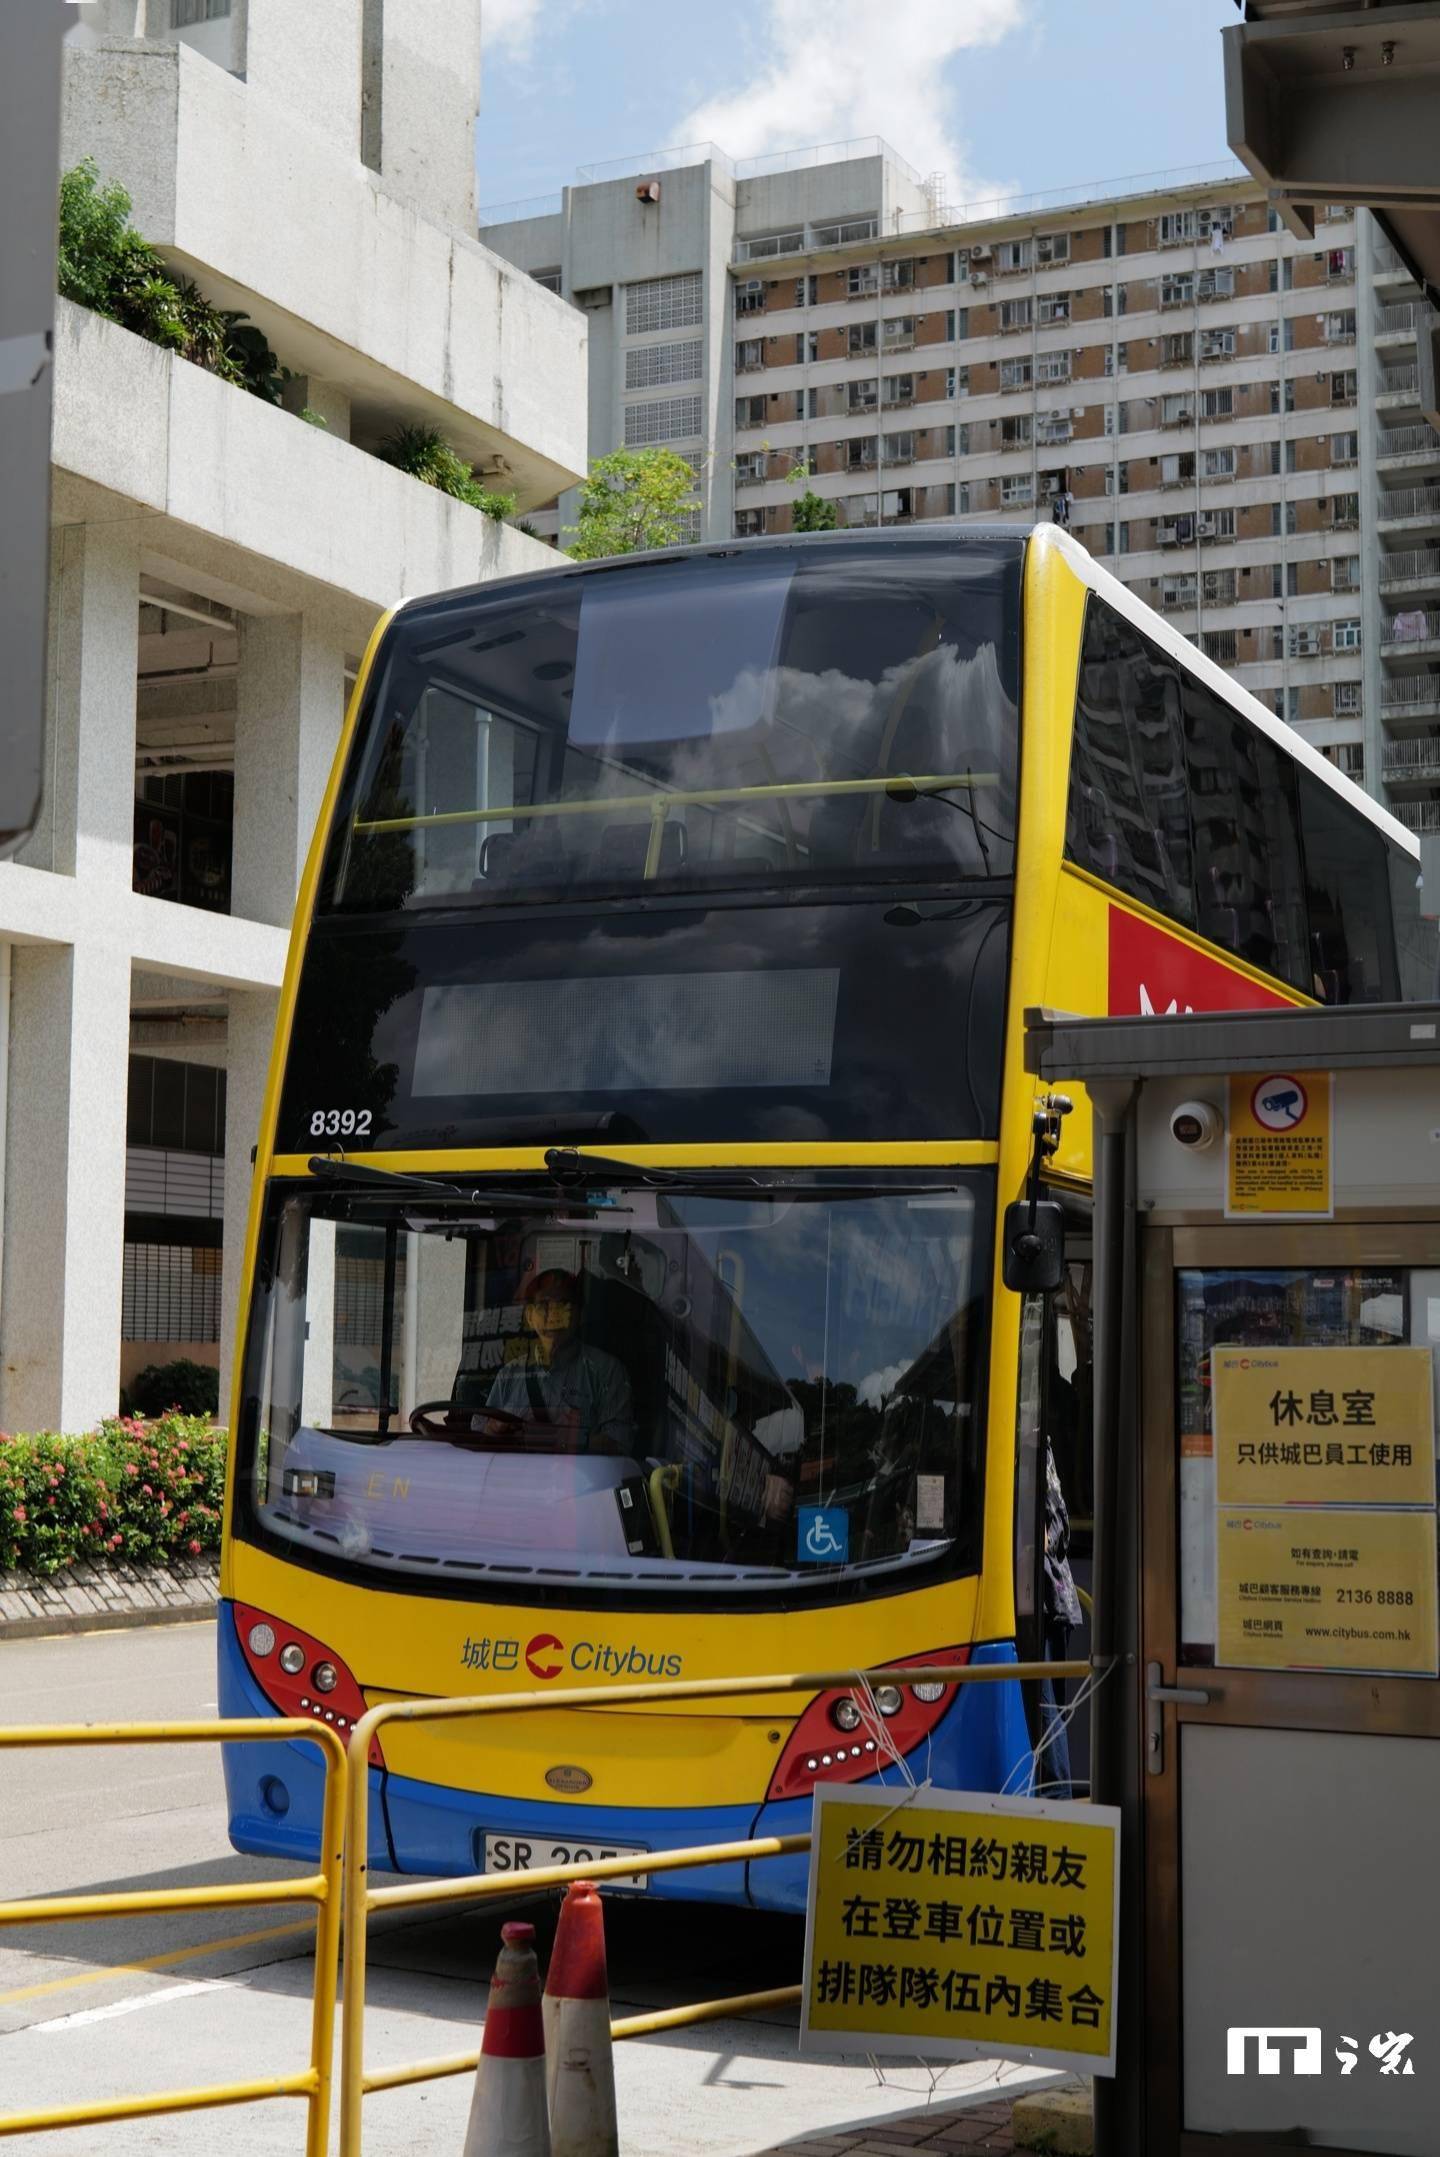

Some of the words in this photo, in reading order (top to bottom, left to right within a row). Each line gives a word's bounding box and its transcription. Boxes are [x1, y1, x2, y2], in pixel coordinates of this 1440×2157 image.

[309, 1109, 373, 1137] 8392
[1269, 1389, 1377, 1427] 休息室
[1236, 1443, 1412, 1467] 只供城巴員工使用
[1337, 1588, 1373, 1604] 2136
[1377, 1590, 1414, 1606] 8888
[1305, 1626, 1411, 1642] www.citybus.com.hk
[460, 1636, 520, 1671] 城巴
[570, 1642, 683, 1677] Citybus
[493, 1841, 532, 1871] SR
[844, 1826, 1088, 1890] 請勿相約親友
[841, 1894, 1087, 1959] 在登車位置或
[816, 1959, 1106, 2029] 排隊隊伍內集合
